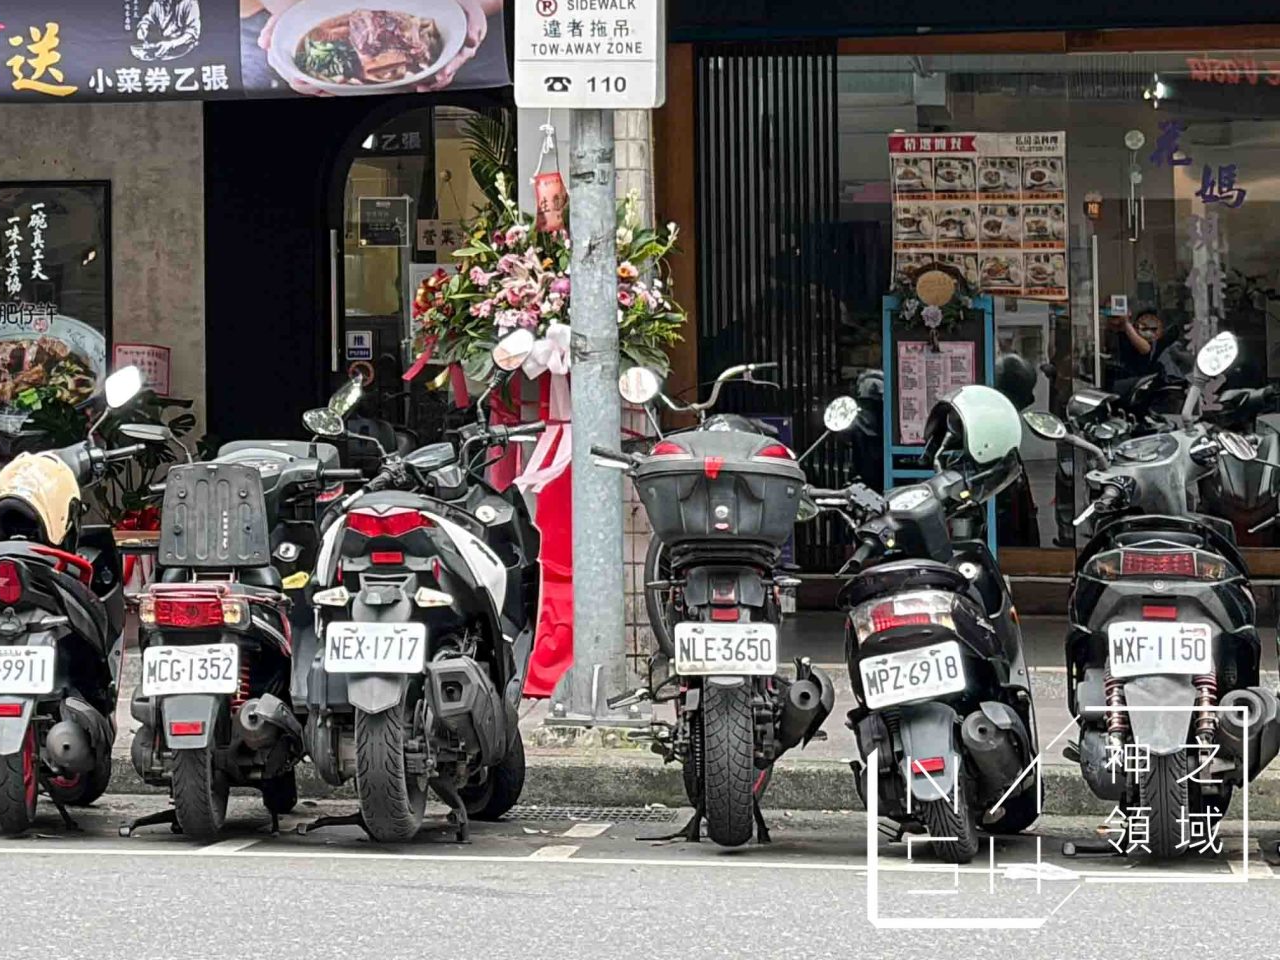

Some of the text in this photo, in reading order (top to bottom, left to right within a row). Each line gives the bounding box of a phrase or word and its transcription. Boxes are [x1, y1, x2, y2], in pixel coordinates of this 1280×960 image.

[531, 41, 643, 57] TOW-AWAY ZONE
[542, 18, 629, 39] 違者拖吊
[7, 23, 79, 98] 送
[88, 64, 230, 94] 小菜券乙張
[587, 76, 627, 93] 110
[5, 216, 24, 296] 一味不妥協
[28, 203, 49, 280] 一碗真工夫
